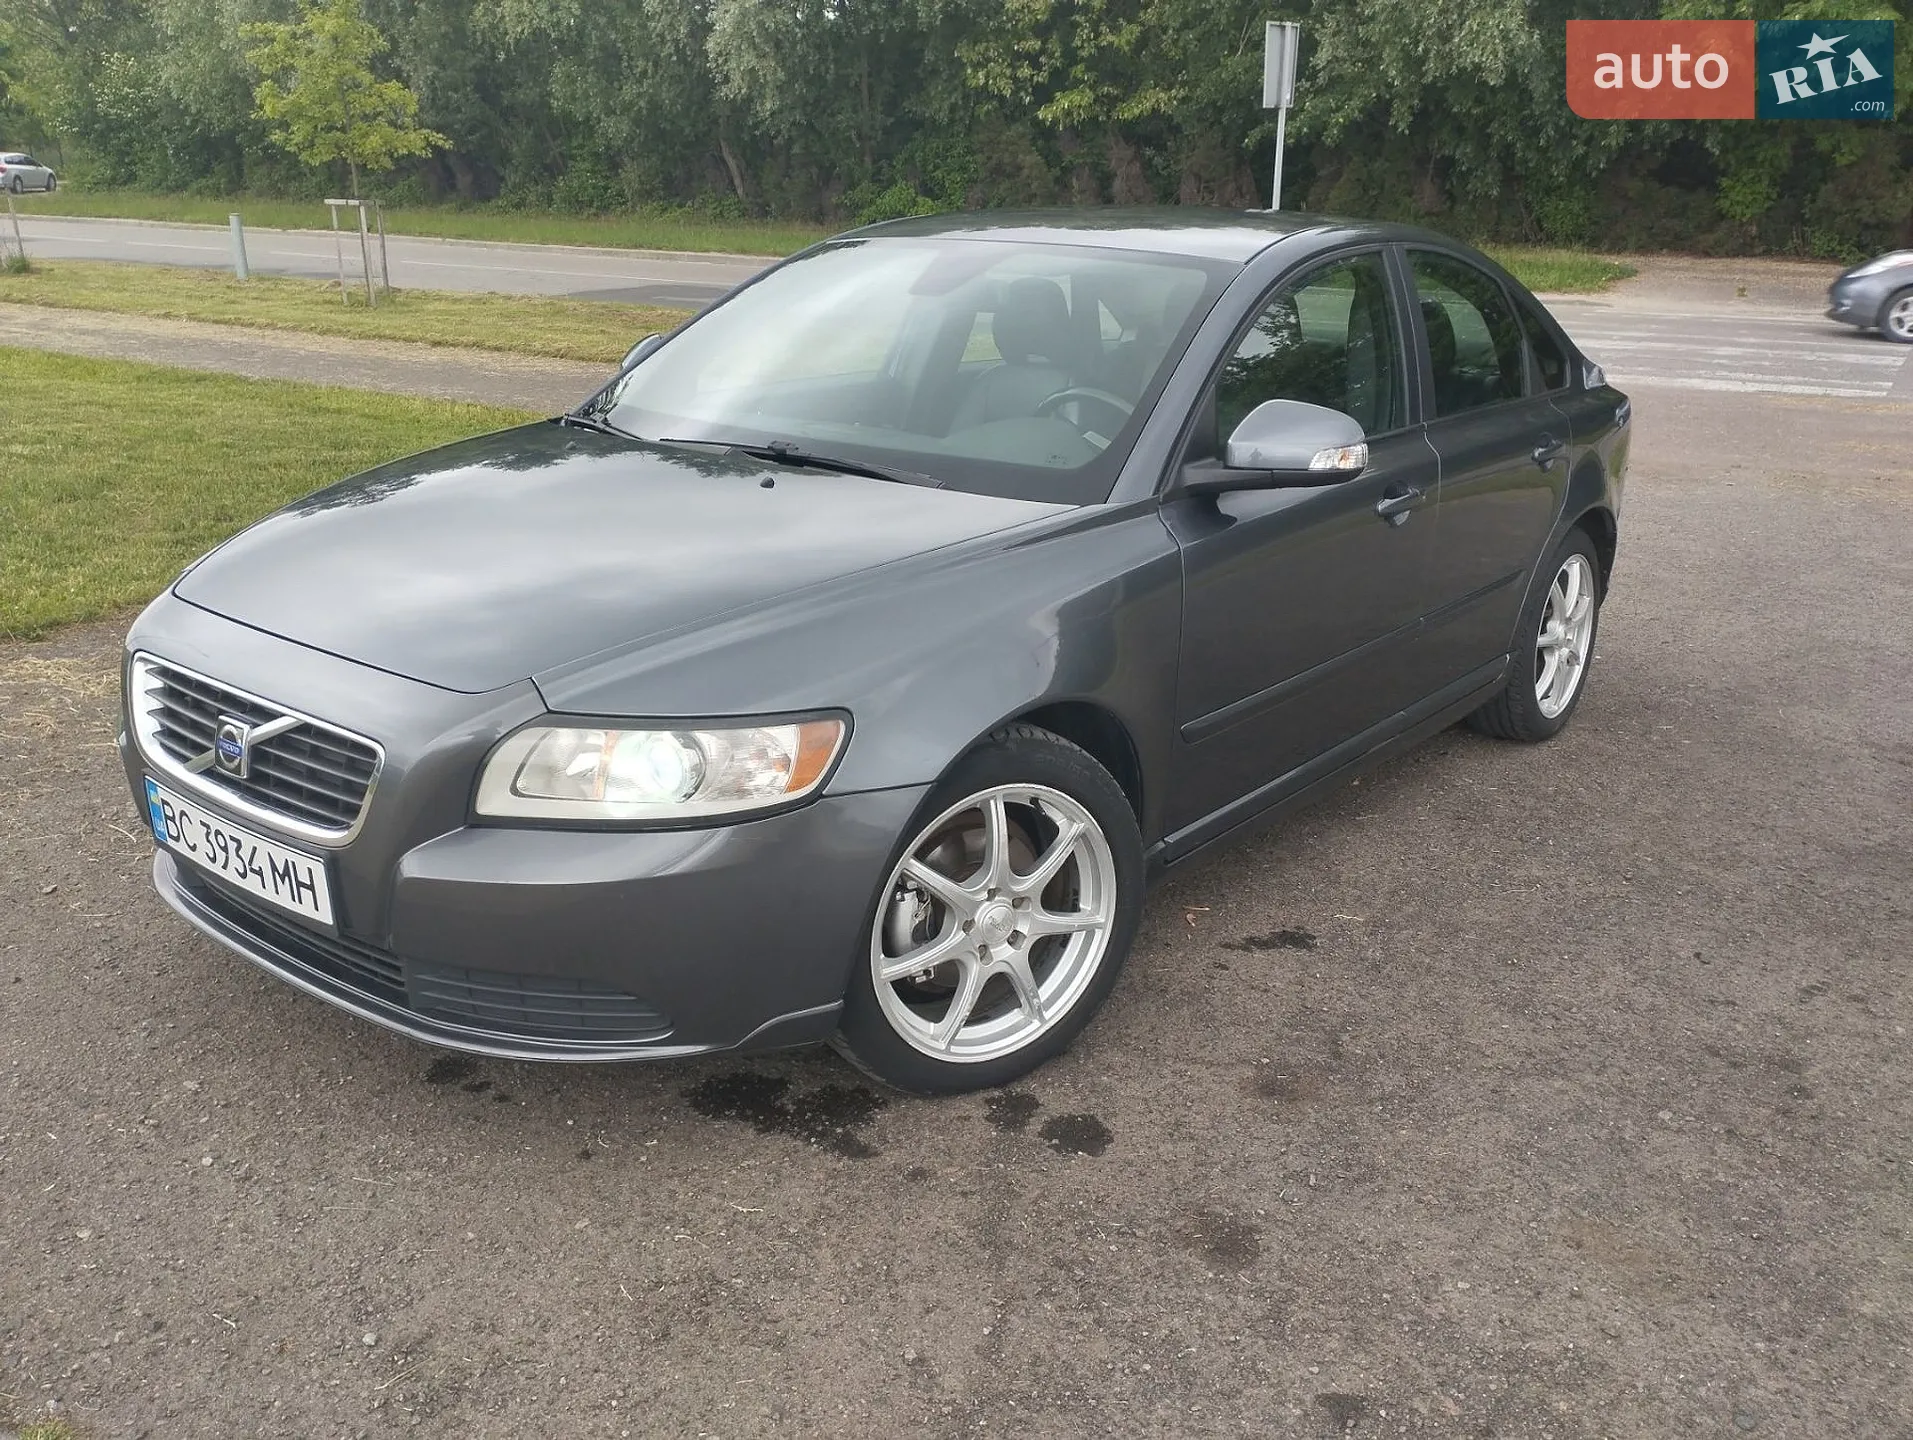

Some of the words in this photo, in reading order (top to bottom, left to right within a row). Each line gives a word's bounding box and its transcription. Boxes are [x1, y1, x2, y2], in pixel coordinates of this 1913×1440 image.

[161, 798, 197, 852] BC
[200, 819, 266, 890] 3934
[267, 851, 319, 912] MH
